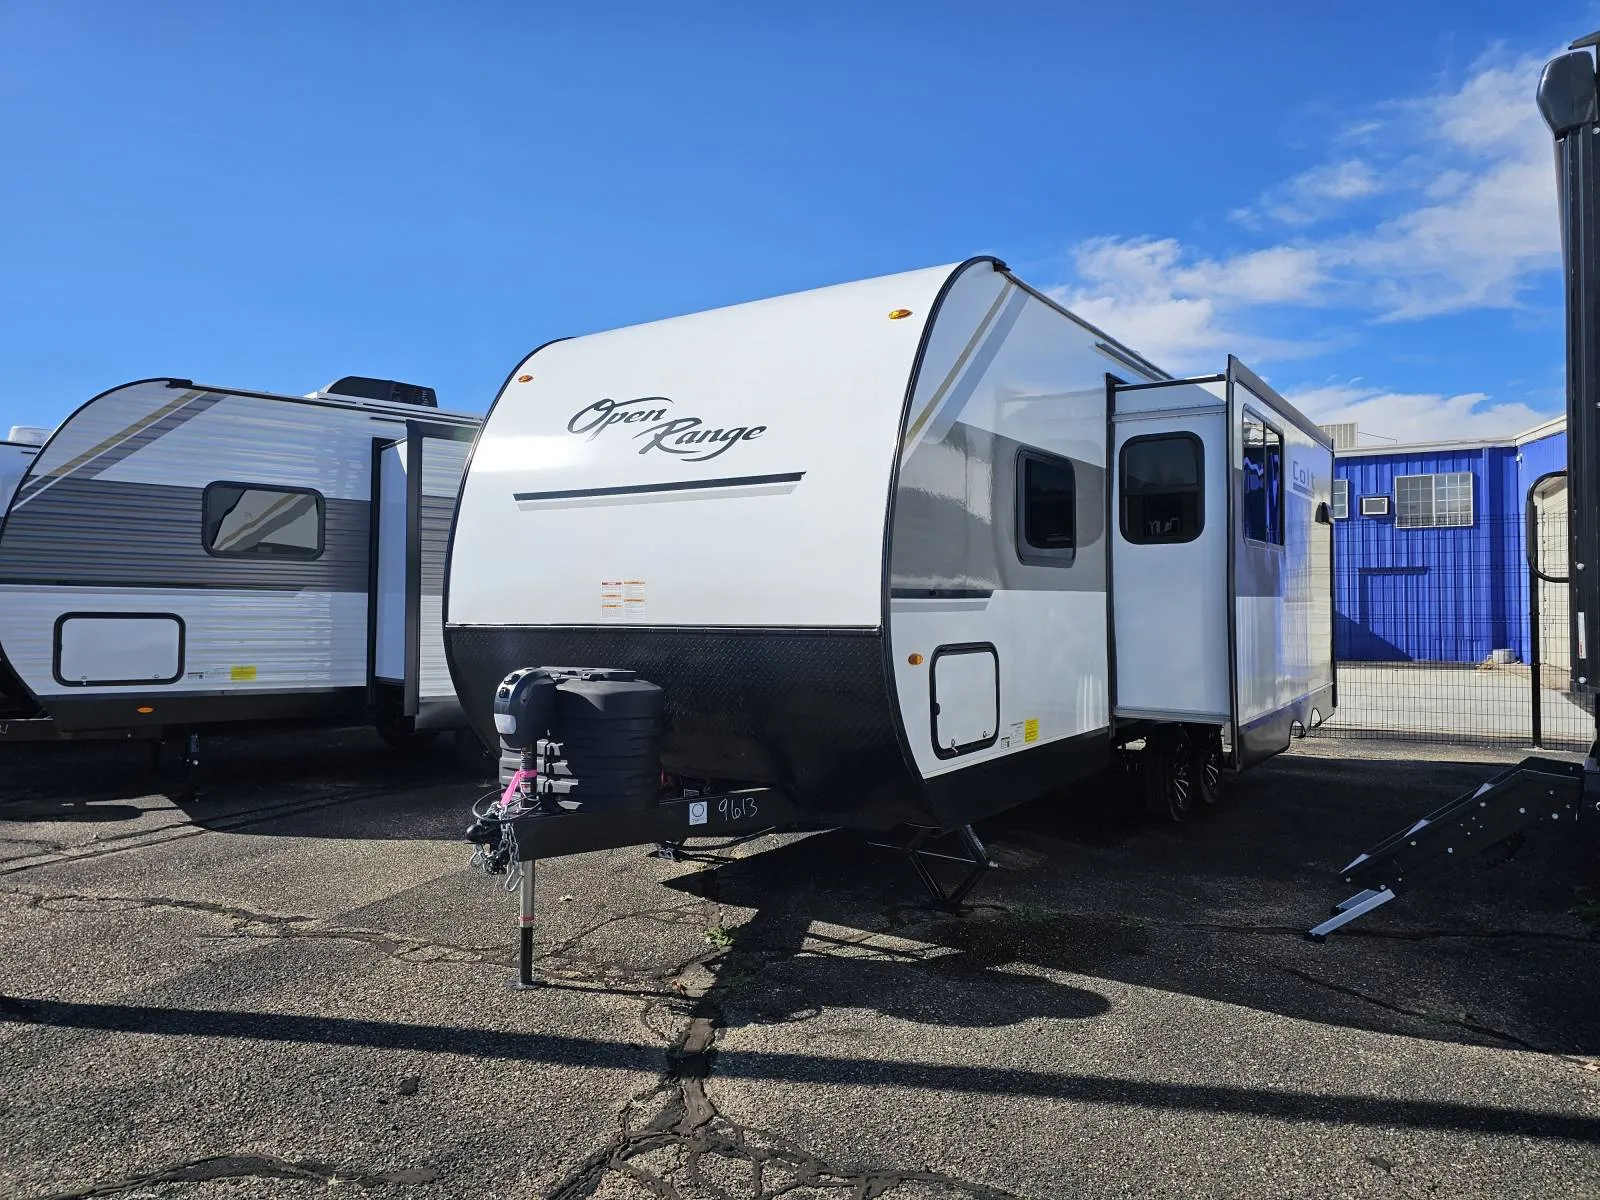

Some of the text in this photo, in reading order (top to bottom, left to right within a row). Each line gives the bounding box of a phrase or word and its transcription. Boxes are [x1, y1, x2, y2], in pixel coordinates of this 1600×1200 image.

[567, 396, 674, 443] Open
[632, 417, 768, 462] Range
[1292, 460, 1316, 490] Colt
[718, 798, 758, 821] 9613
